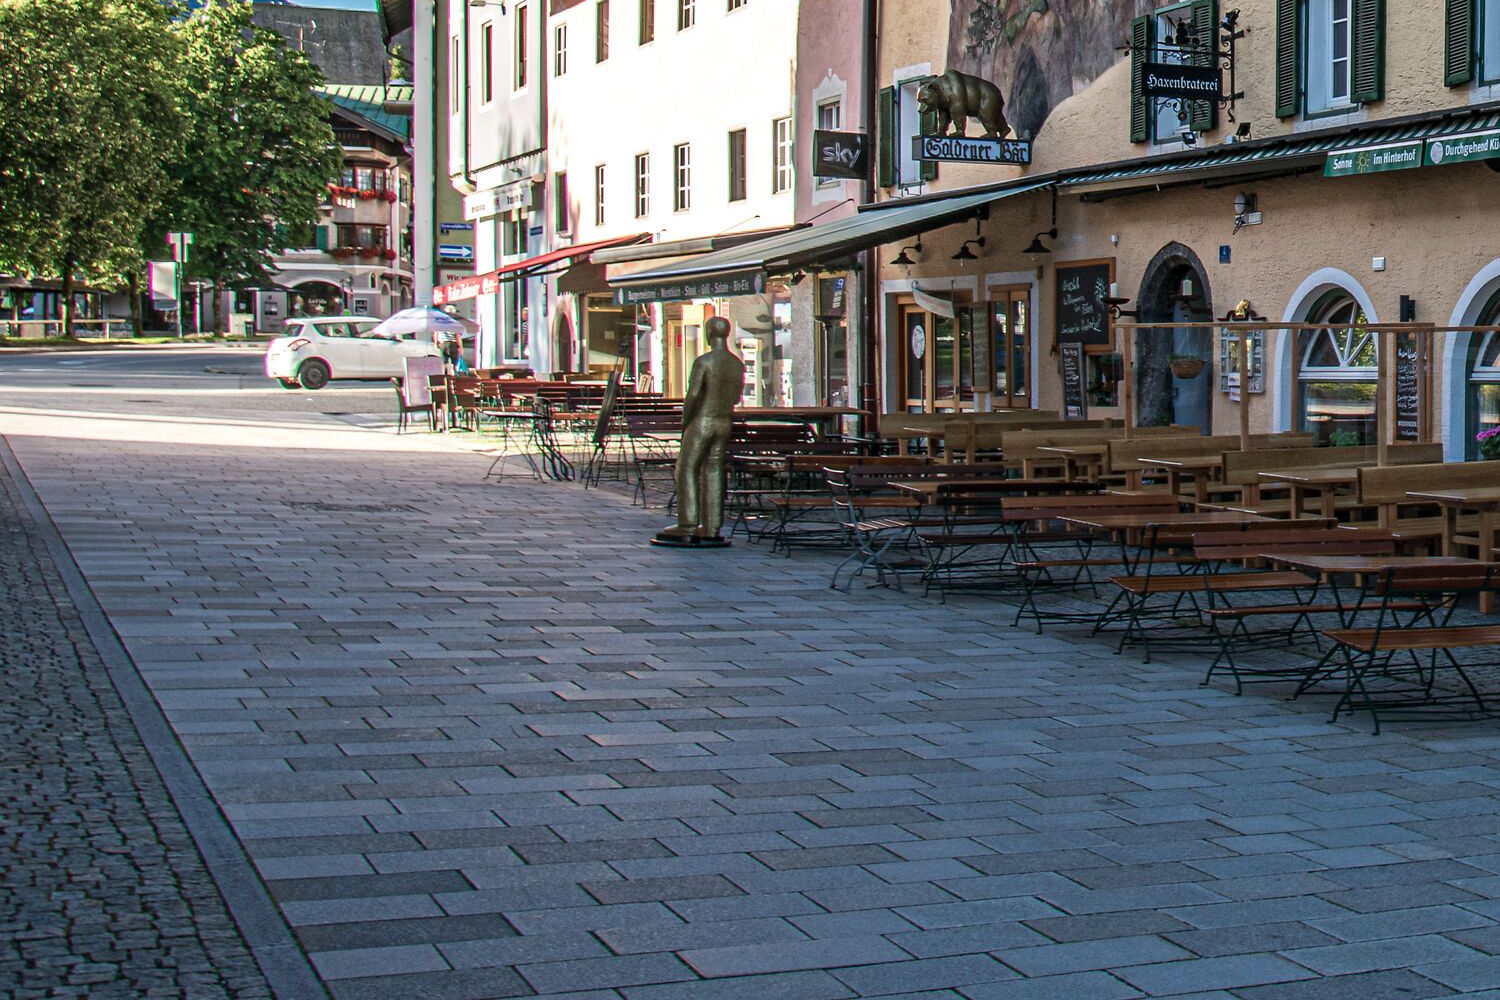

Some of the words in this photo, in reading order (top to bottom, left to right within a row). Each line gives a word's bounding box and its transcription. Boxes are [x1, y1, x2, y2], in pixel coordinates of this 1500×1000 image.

[1147, 73, 1219, 91] Haxenbraterei
[823, 136, 862, 168] sky
[926, 138, 992, 160] Goldener
[996, 140, 1027, 161] Bär
[1445, 138, 1489, 157] Durchgehend
[1333, 157, 1353, 170] Sonne
[1373, 153, 1383, 165] im
[1384, 149, 1416, 164] Hinterhof
